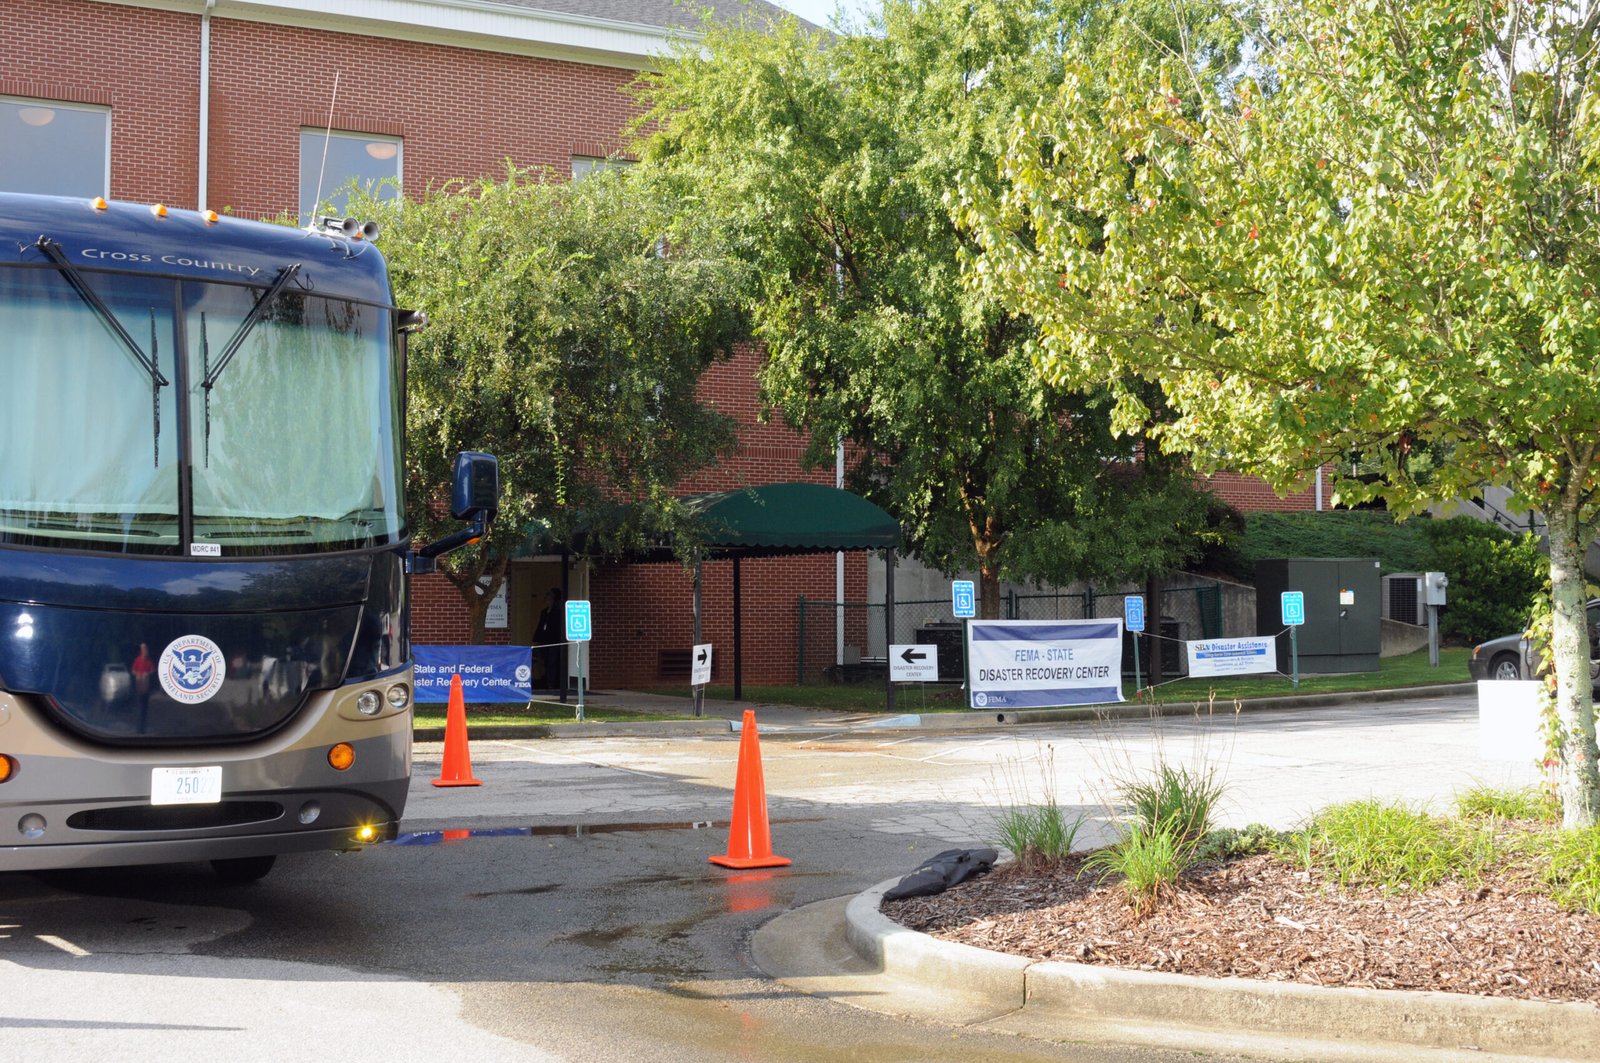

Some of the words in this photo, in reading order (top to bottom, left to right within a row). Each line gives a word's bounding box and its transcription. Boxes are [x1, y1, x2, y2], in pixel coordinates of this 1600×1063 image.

[81, 248, 151, 262] Cross
[160, 255, 260, 276] Country
[173, 639, 217, 655] DEPARTMENT
[1211, 642, 1236, 651] Disaster
[1014, 649, 1040, 662] FEMA
[1047, 648, 1074, 662] STATE
[413, 664, 436, 674] State
[438, 664, 456, 674] and
[458, 664, 493, 674] Federal
[979, 668, 1023, 682] DISASTER
[1026, 667, 1075, 680] RECOVERY
[1076, 665, 1110, 679] CENTER
[162, 673, 194, 700] HOMELAND
[196, 673, 222, 699] SECURITY
[436, 677, 480, 688] Recvery
[481, 678, 512, 687] Center
